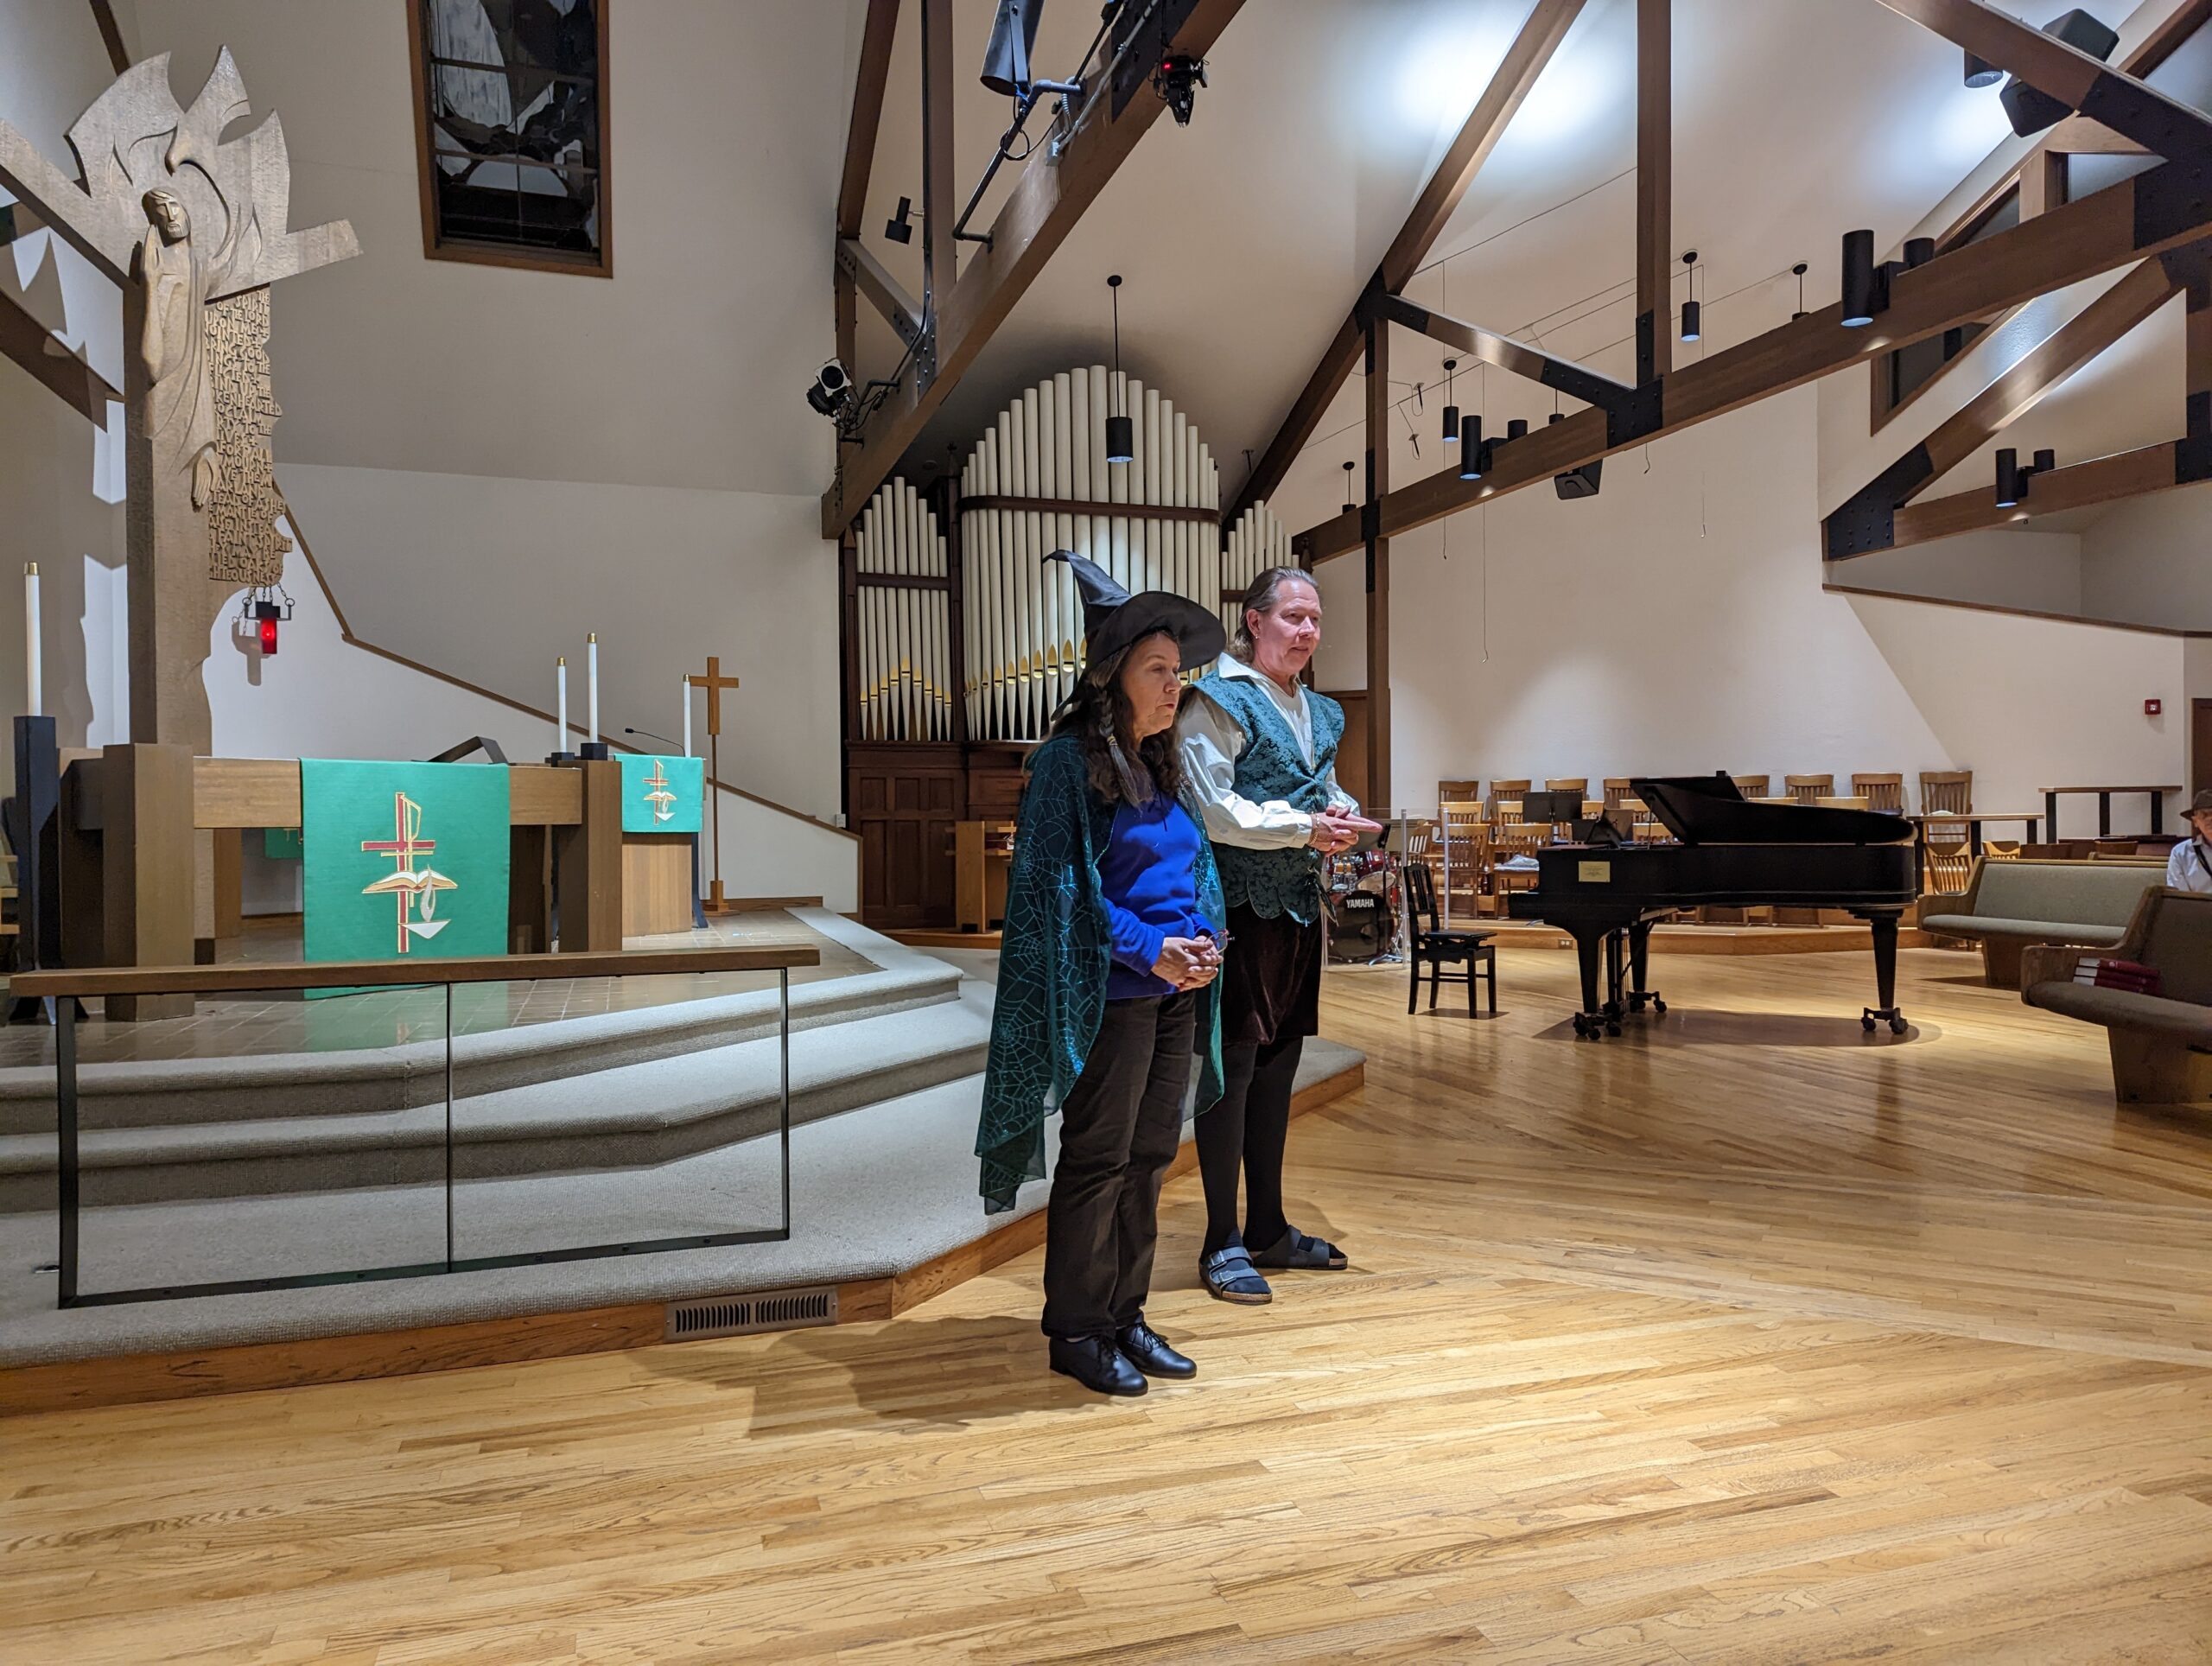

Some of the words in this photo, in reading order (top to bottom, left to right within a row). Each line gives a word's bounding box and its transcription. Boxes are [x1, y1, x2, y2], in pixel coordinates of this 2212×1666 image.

[235, 295, 270, 314] SPIRIT
[257, 290, 270, 302] THE
[217, 302, 230, 316] OF
[231, 308, 243, 321] THE
[205, 311, 234, 330] UPON
[240, 347, 270, 364] GOOD
[257, 361, 270, 374] THE
[1346, 899, 1375, 908] YAMAHA
